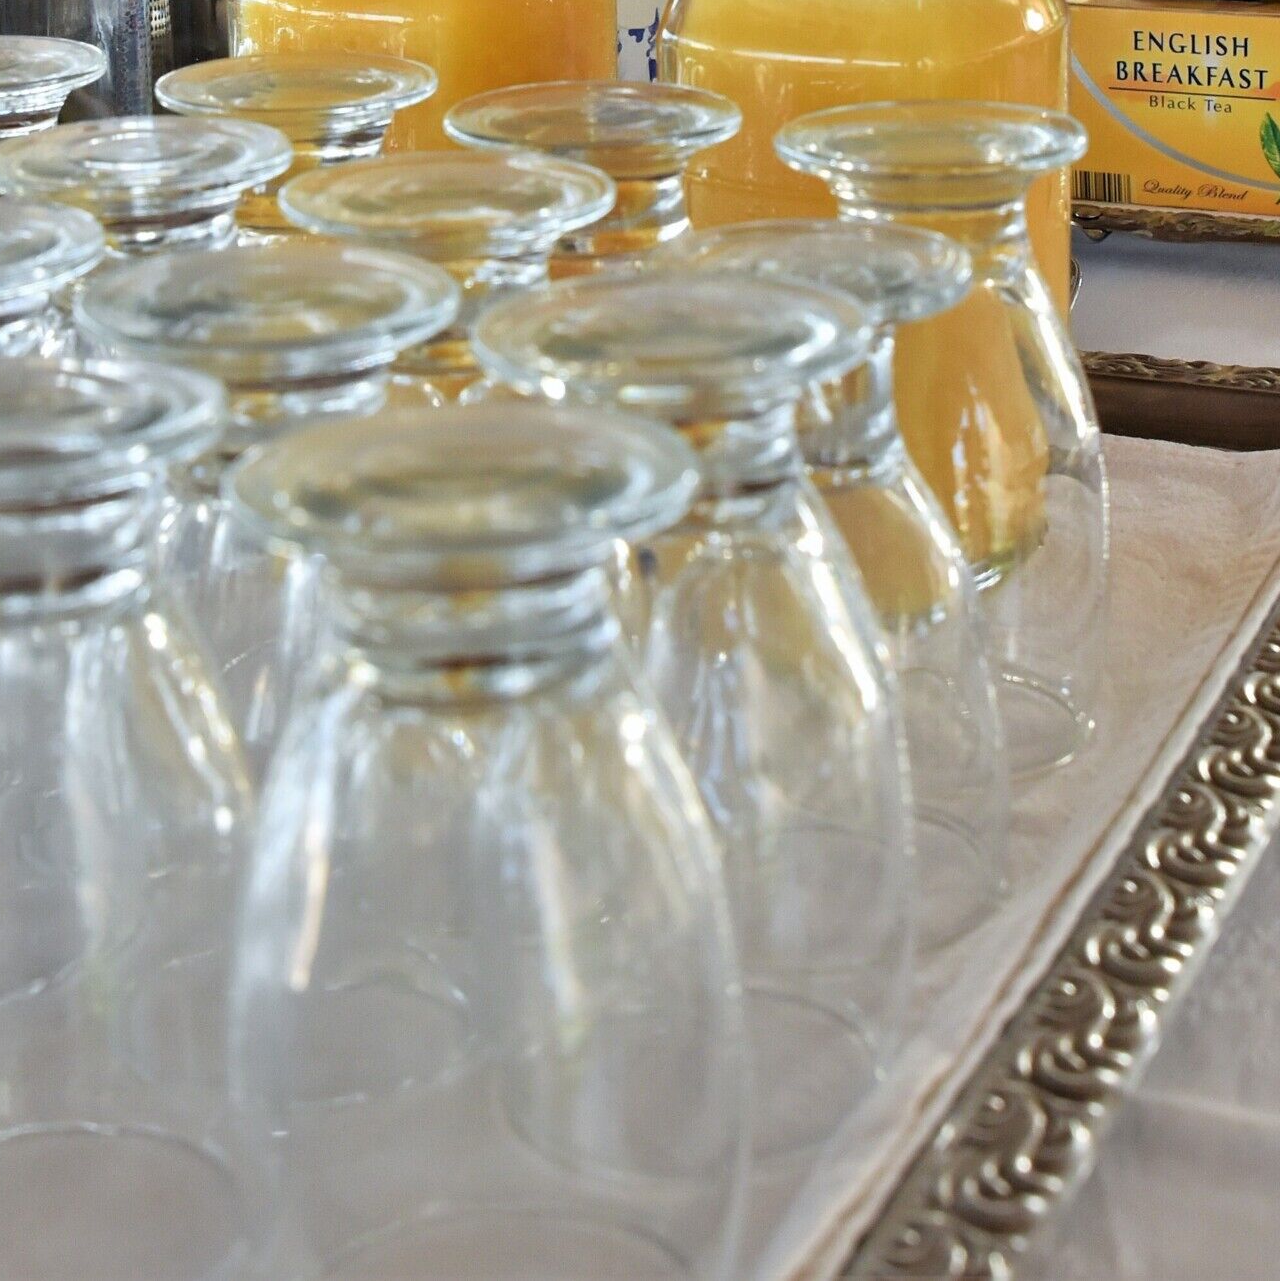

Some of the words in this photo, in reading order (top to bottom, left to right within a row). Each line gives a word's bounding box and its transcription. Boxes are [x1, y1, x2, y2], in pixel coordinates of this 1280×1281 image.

[1133, 30, 1249, 57] ENGLISH
[1116, 60, 1269, 90] BREAKFAST
[1149, 95, 1196, 111] Black
[1204, 99, 1232, 113] Tea
[1143, 179, 1192, 200] Quality
[1197, 183, 1249, 200] Blend
